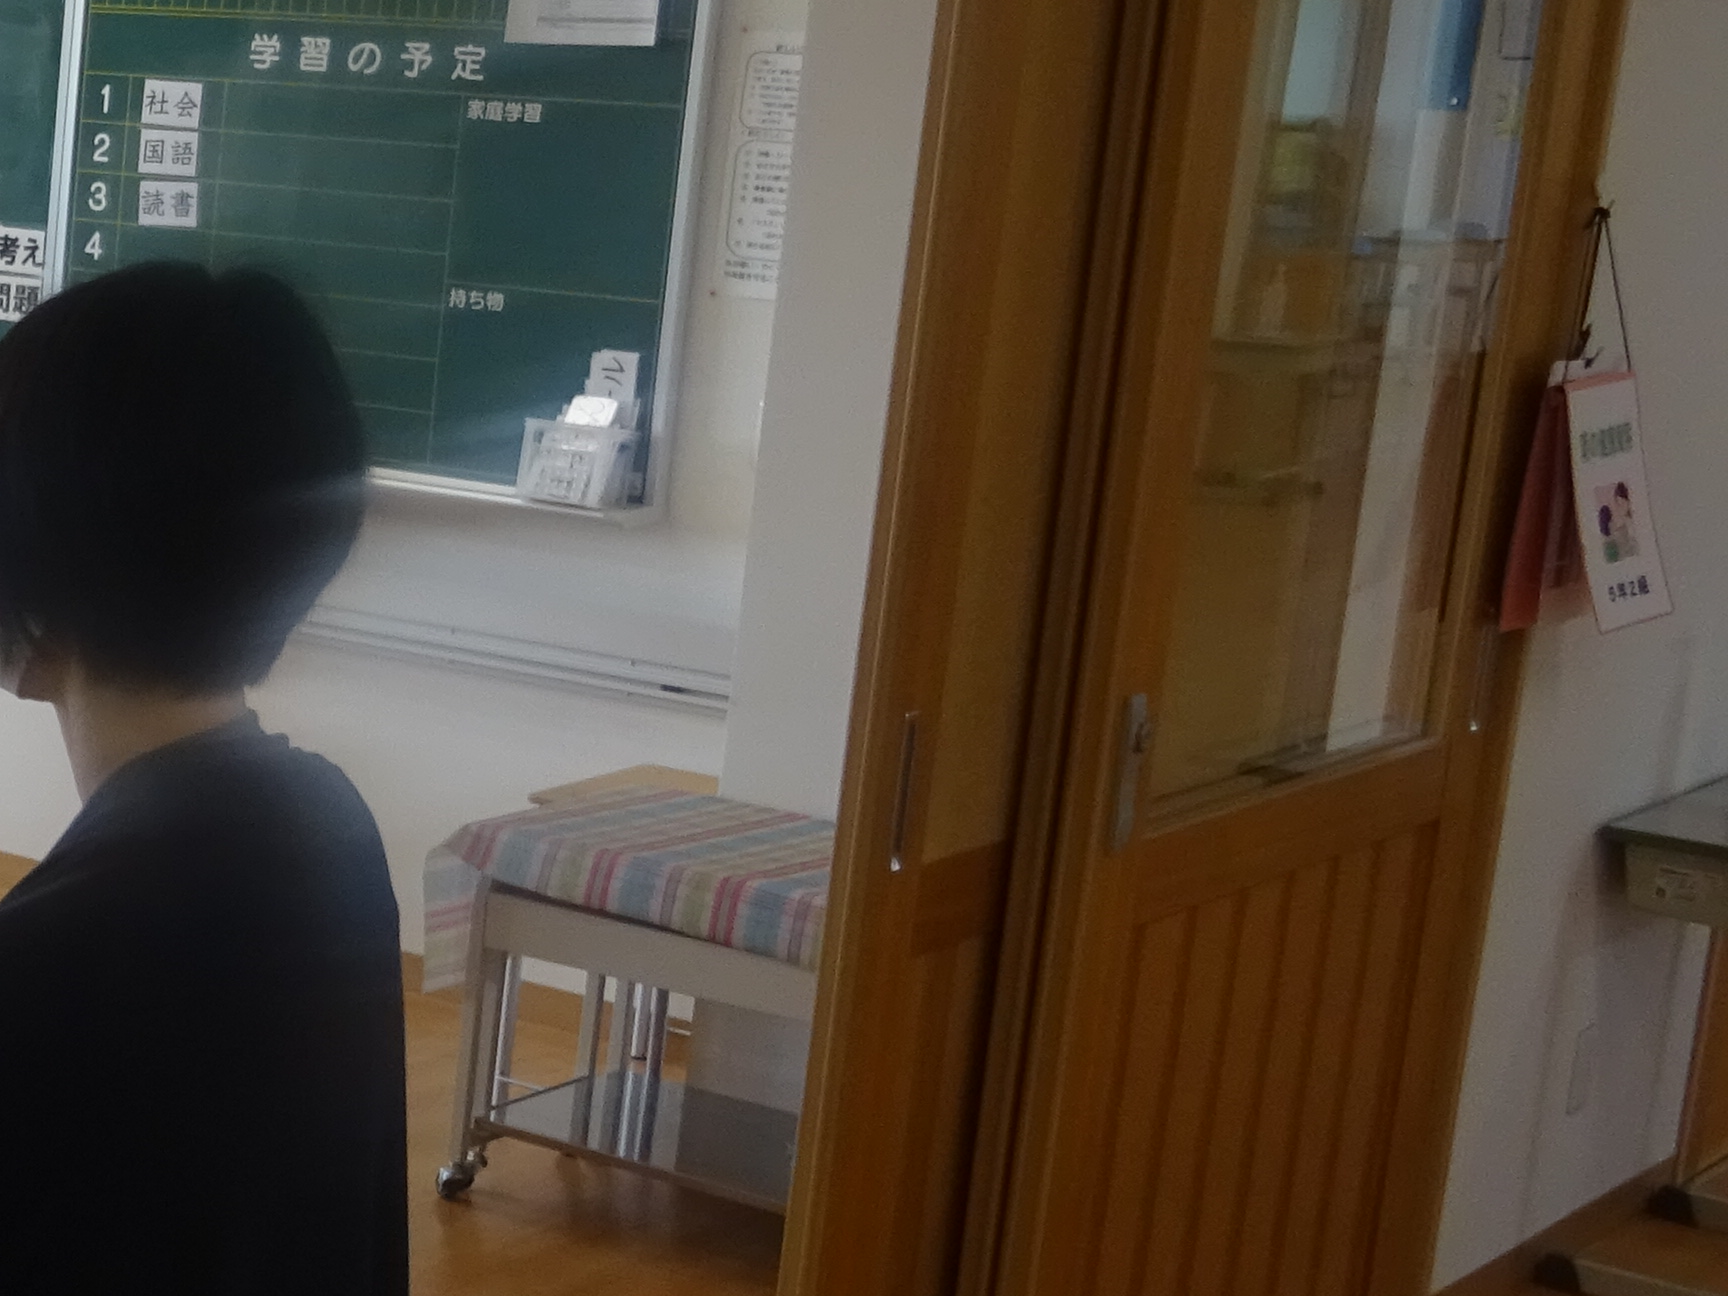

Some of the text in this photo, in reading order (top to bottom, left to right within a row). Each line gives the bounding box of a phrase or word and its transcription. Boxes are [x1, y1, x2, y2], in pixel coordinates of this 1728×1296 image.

[249, 33, 487, 82] 学習の予定
[100, 84, 199, 119] 1 社会
[466, 98, 543, 123] 家庭学習
[92, 132, 196, 167] 2 国語
[87, 181, 196, 219] 3 読書
[84, 230, 103, 261] 4
[448, 287, 505, 312] 持ち物
